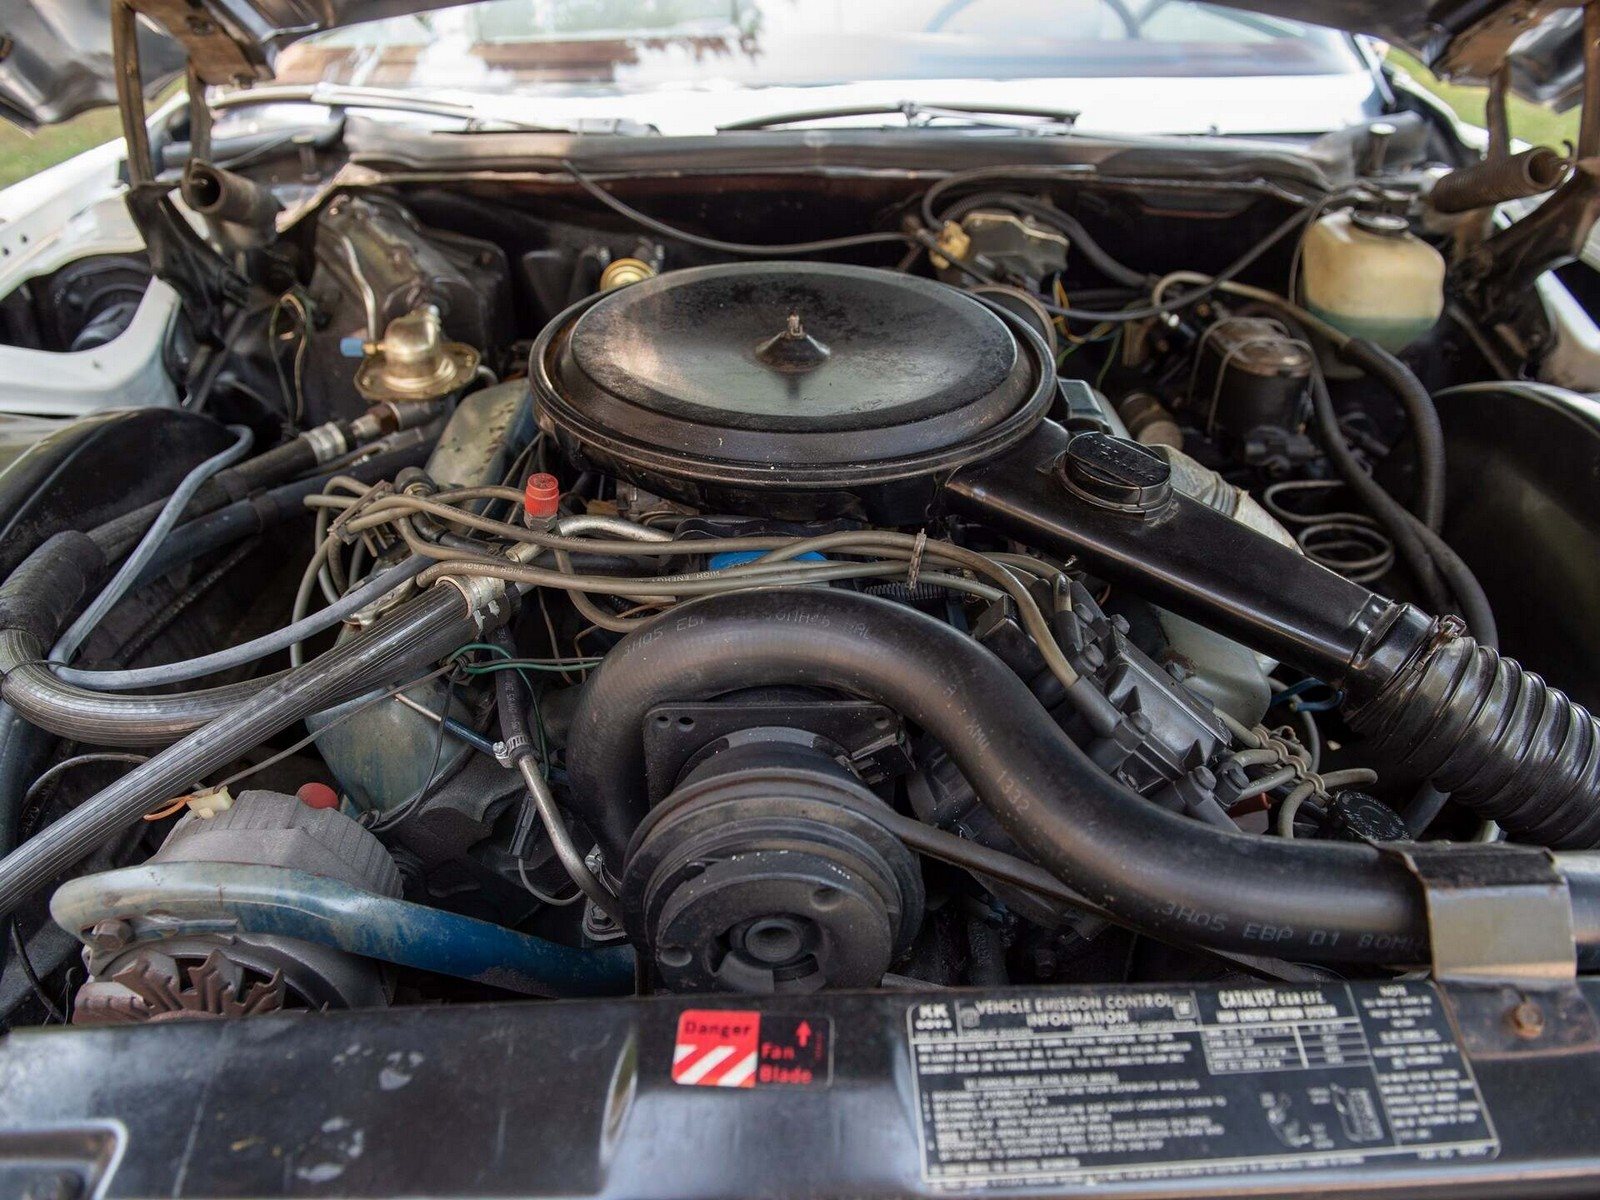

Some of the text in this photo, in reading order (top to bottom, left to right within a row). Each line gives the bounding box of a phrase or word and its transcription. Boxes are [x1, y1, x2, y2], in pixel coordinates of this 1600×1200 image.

[974, 992, 1174, 1016] VEHICLE EMISSION CONTROL
[1025, 1010, 1130, 1028] INFORMATION
[684, 1021, 751, 1039] Danger
[761, 1042, 795, 1061] Fan
[759, 1063, 813, 1085] Blade
